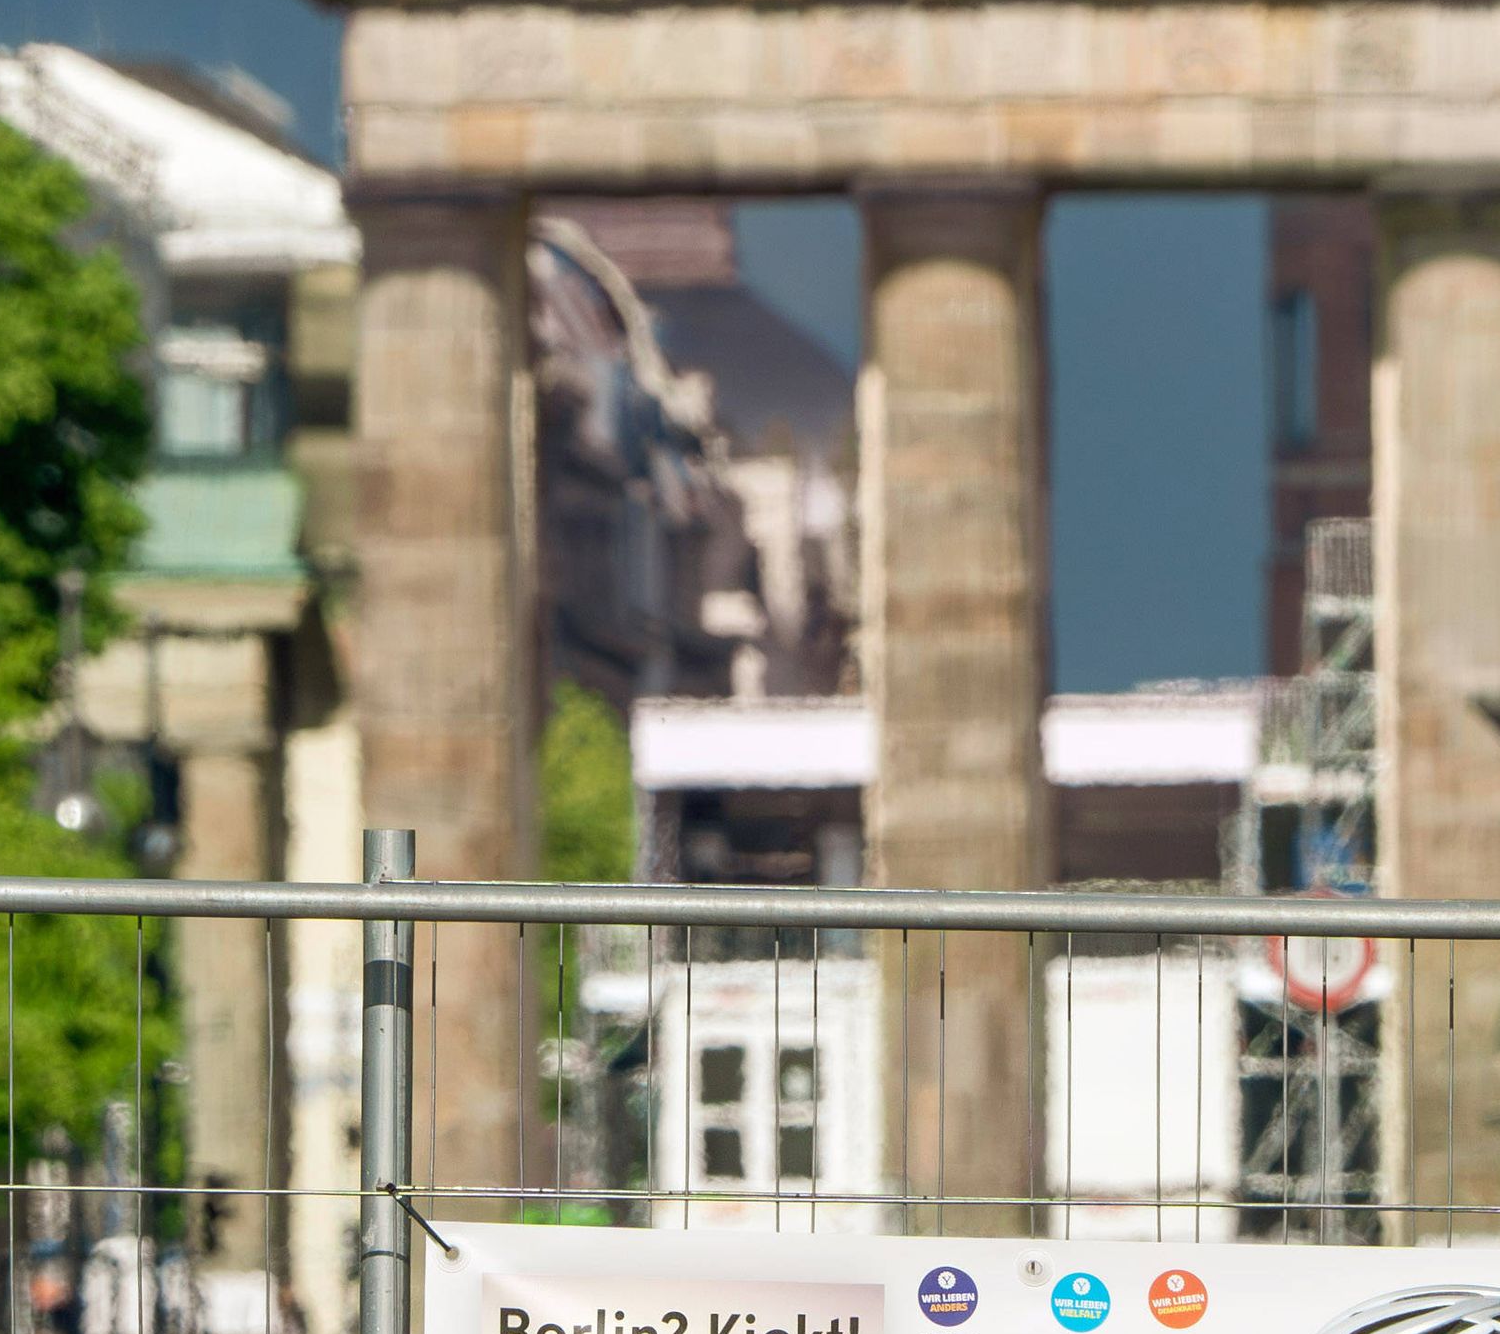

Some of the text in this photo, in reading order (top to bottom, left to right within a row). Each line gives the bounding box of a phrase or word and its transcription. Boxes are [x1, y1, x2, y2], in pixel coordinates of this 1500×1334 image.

[921, 1292, 975, 1304] WIR LIEBEN
[1054, 1298, 1108, 1310] WIR LIEBEN
[1152, 1294, 1205, 1308] WIR LIEBEN
[930, 1302, 968, 1313] ANDERS
[1060, 1308, 1102, 1319] VIELFALT
